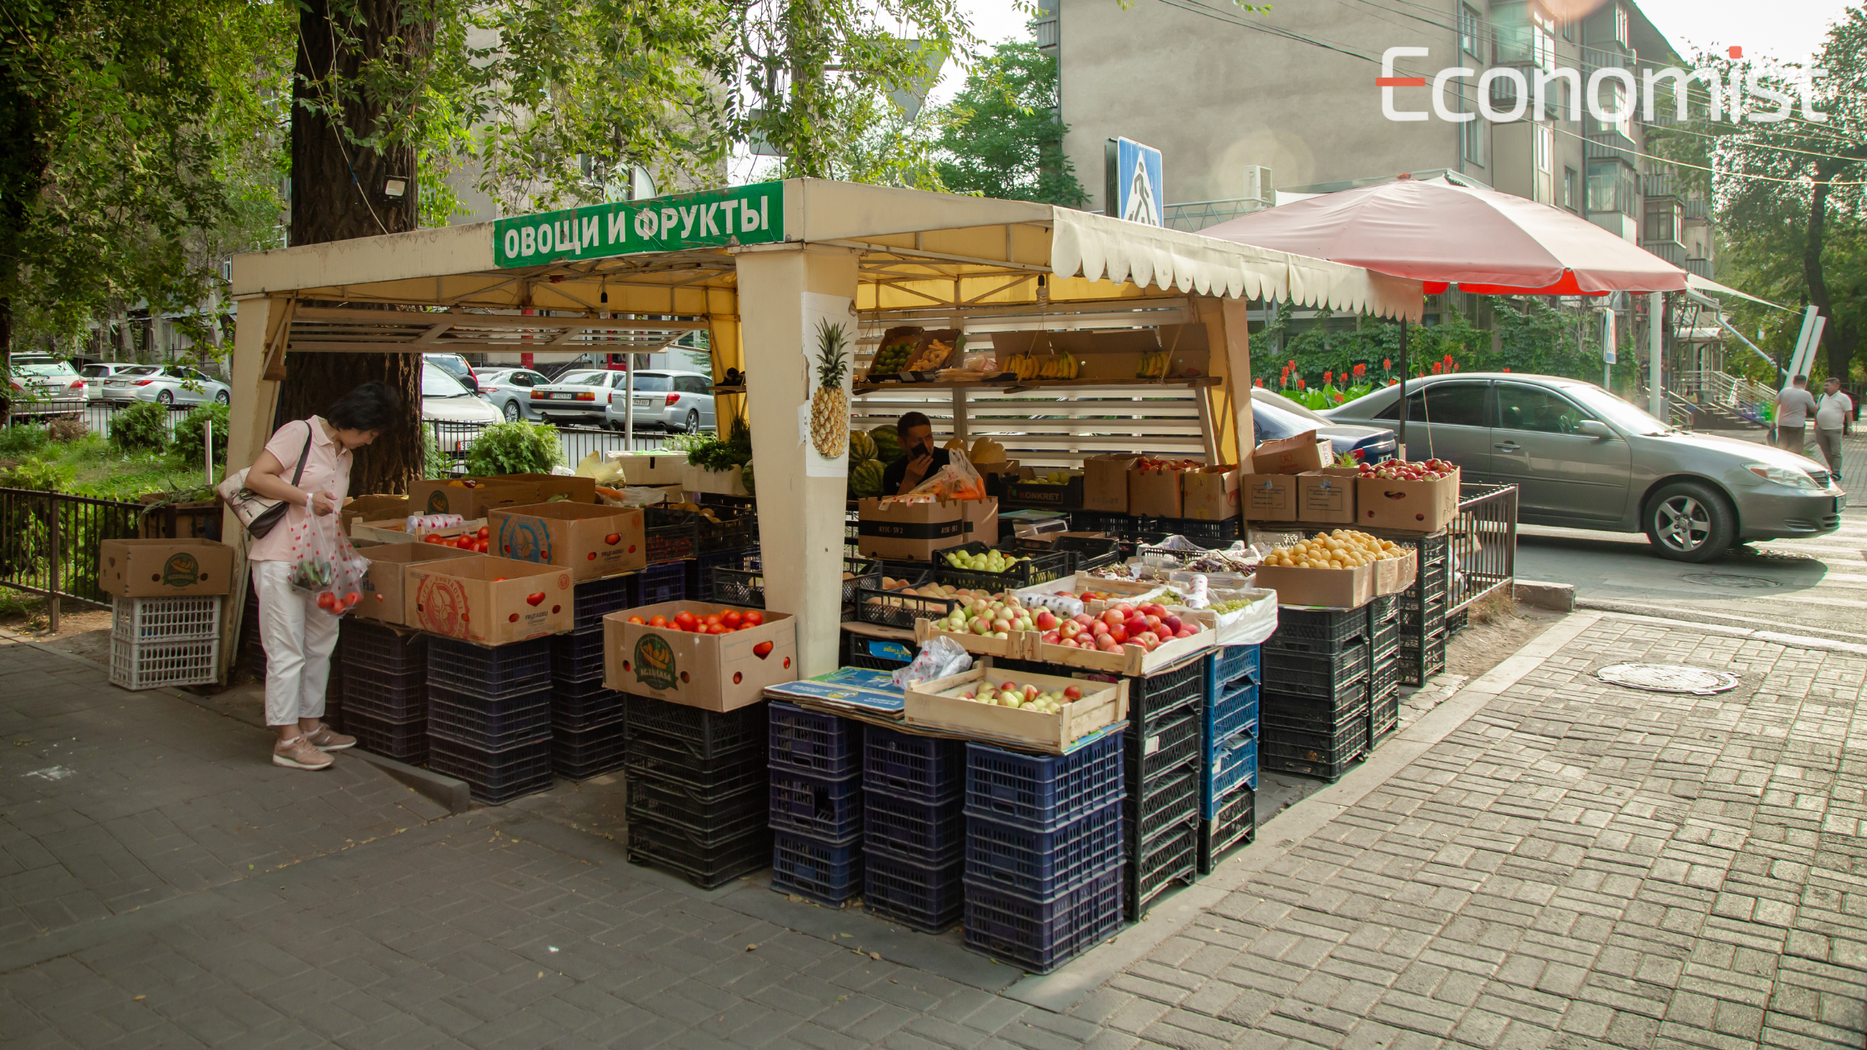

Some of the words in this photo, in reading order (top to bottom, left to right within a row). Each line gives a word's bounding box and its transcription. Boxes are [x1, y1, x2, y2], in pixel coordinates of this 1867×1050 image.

[504, 215, 600, 259] ОВОЩИ
[607, 211, 626, 245] И
[634, 195, 769, 244] ФРУКТЫ
[1019, 491, 1060, 500] KONKRET
[435, 575, 464, 610] FRUTADELI
